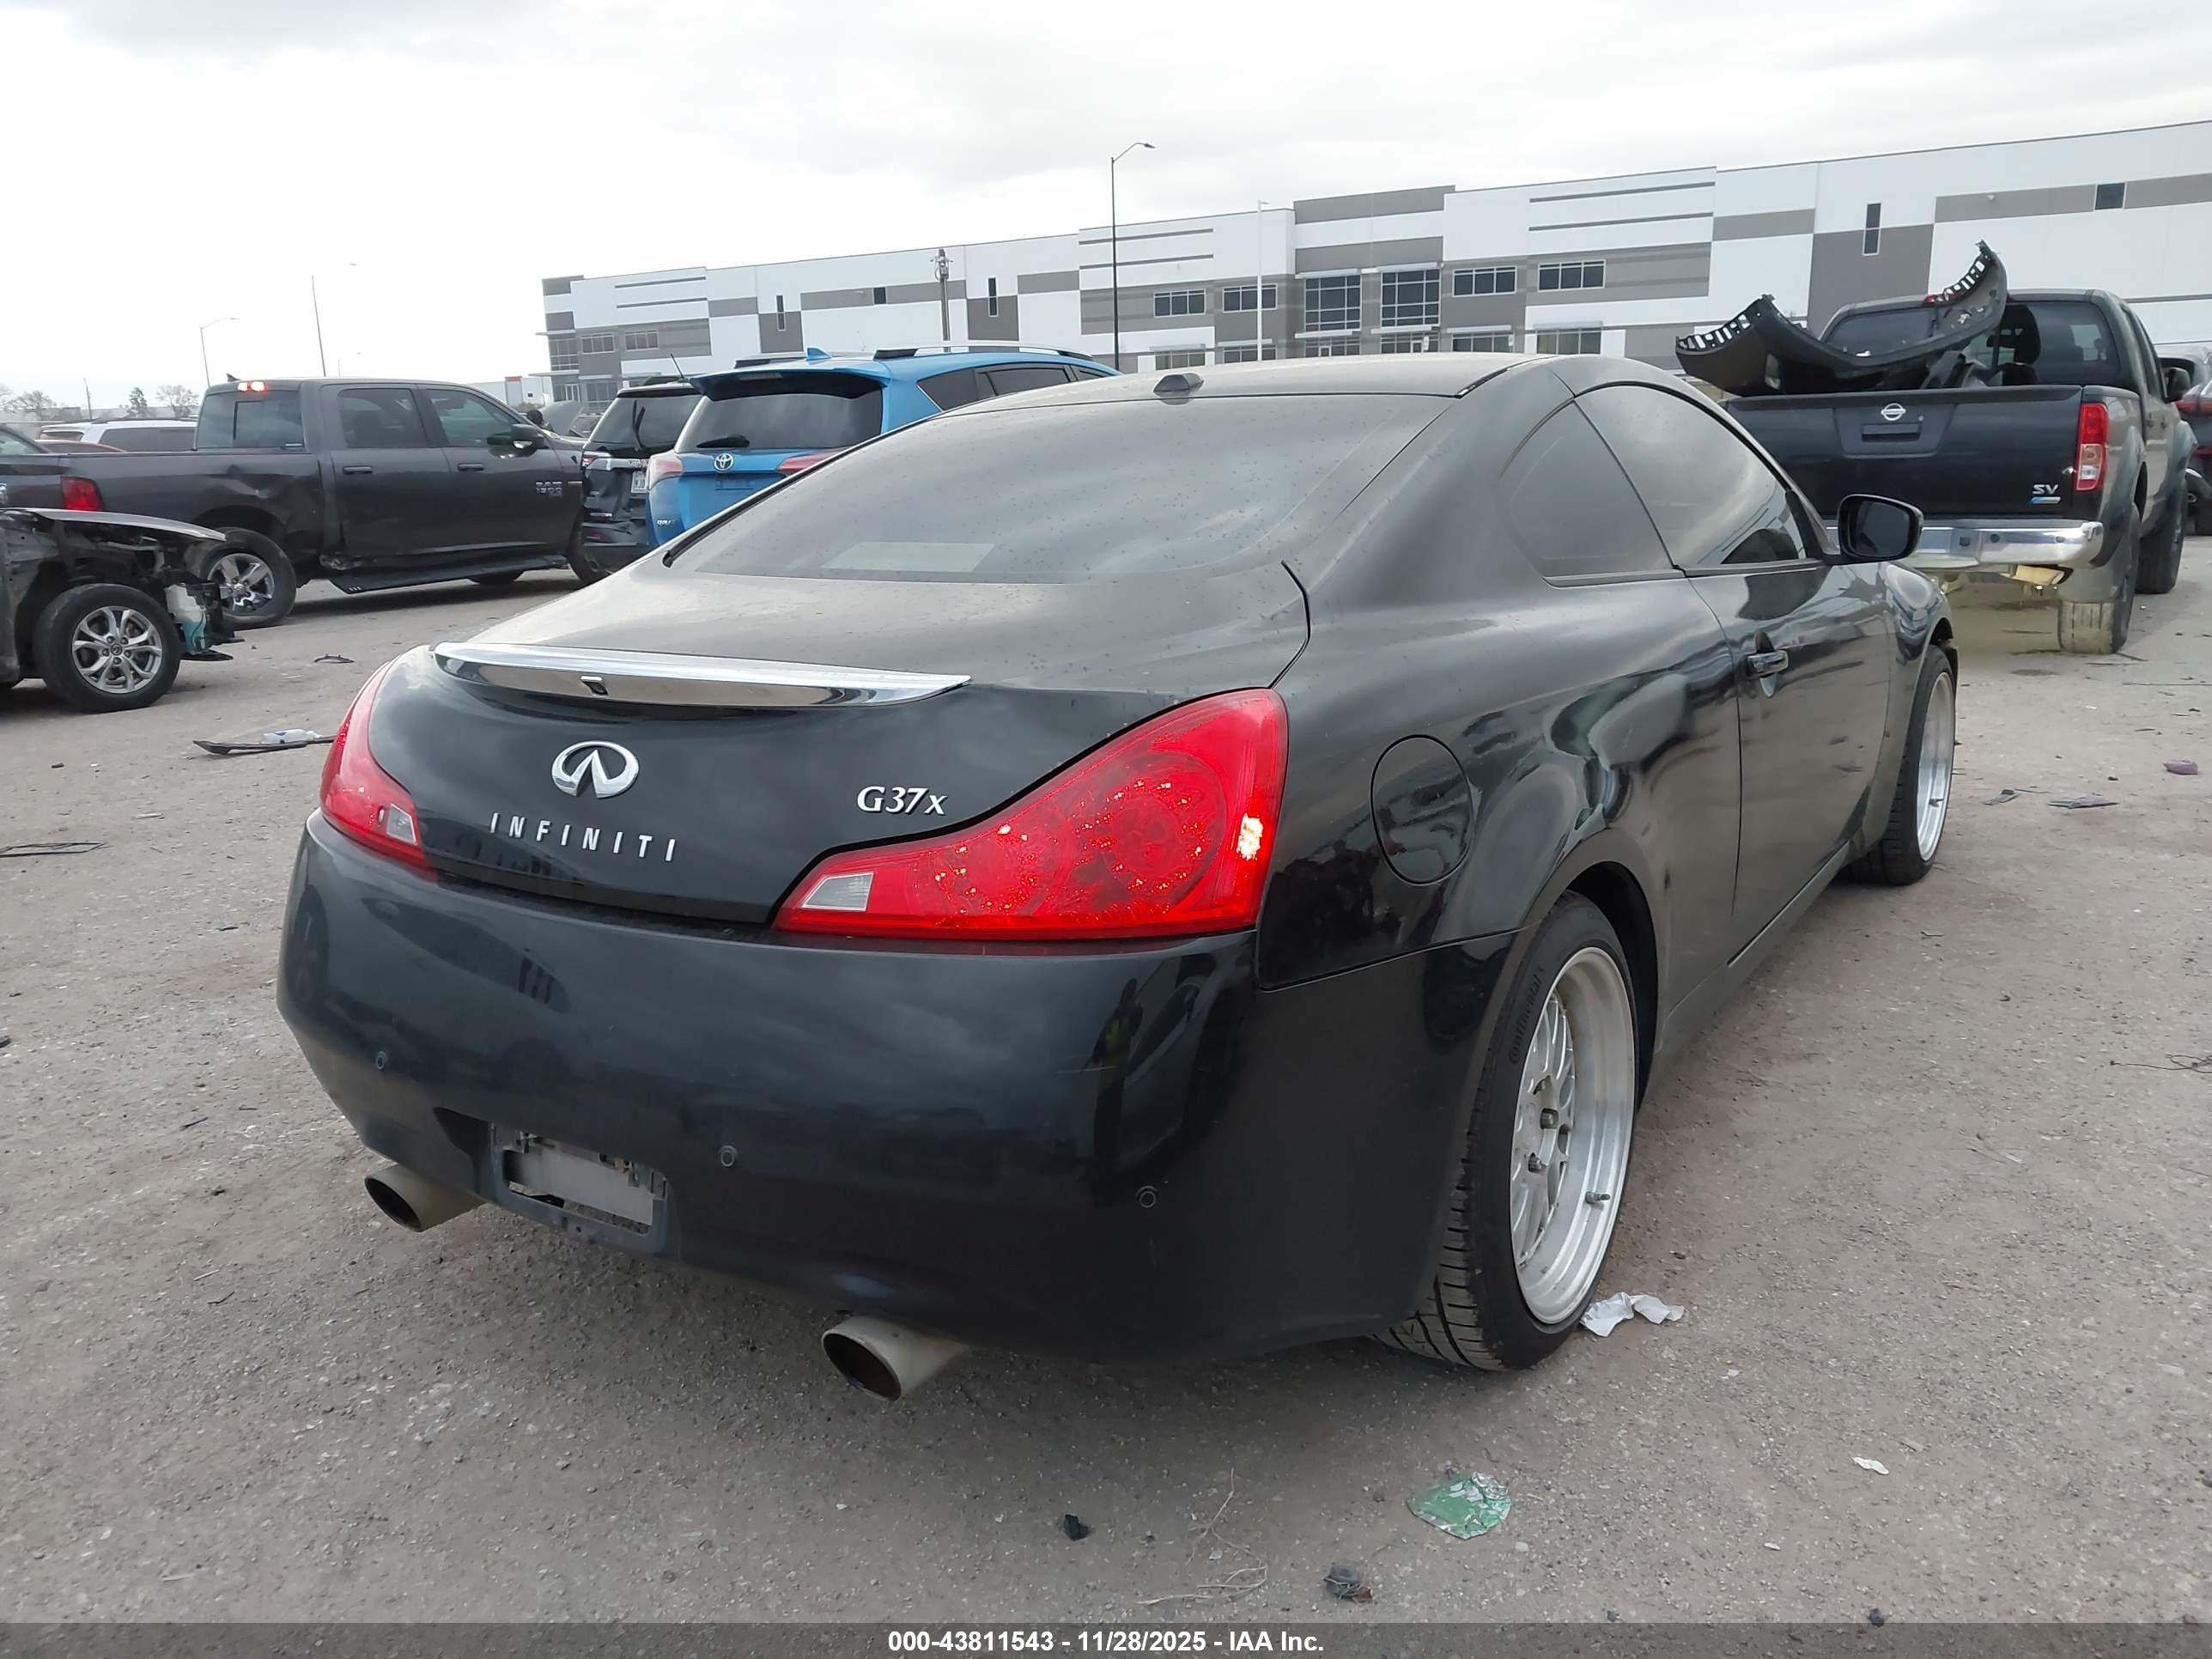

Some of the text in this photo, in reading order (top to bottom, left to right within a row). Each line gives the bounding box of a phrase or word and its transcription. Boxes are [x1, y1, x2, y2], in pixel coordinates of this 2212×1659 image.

[2032, 483, 2059, 495] SV
[856, 785, 946, 816] G37x
[489, 812, 677, 862] INFINITI
